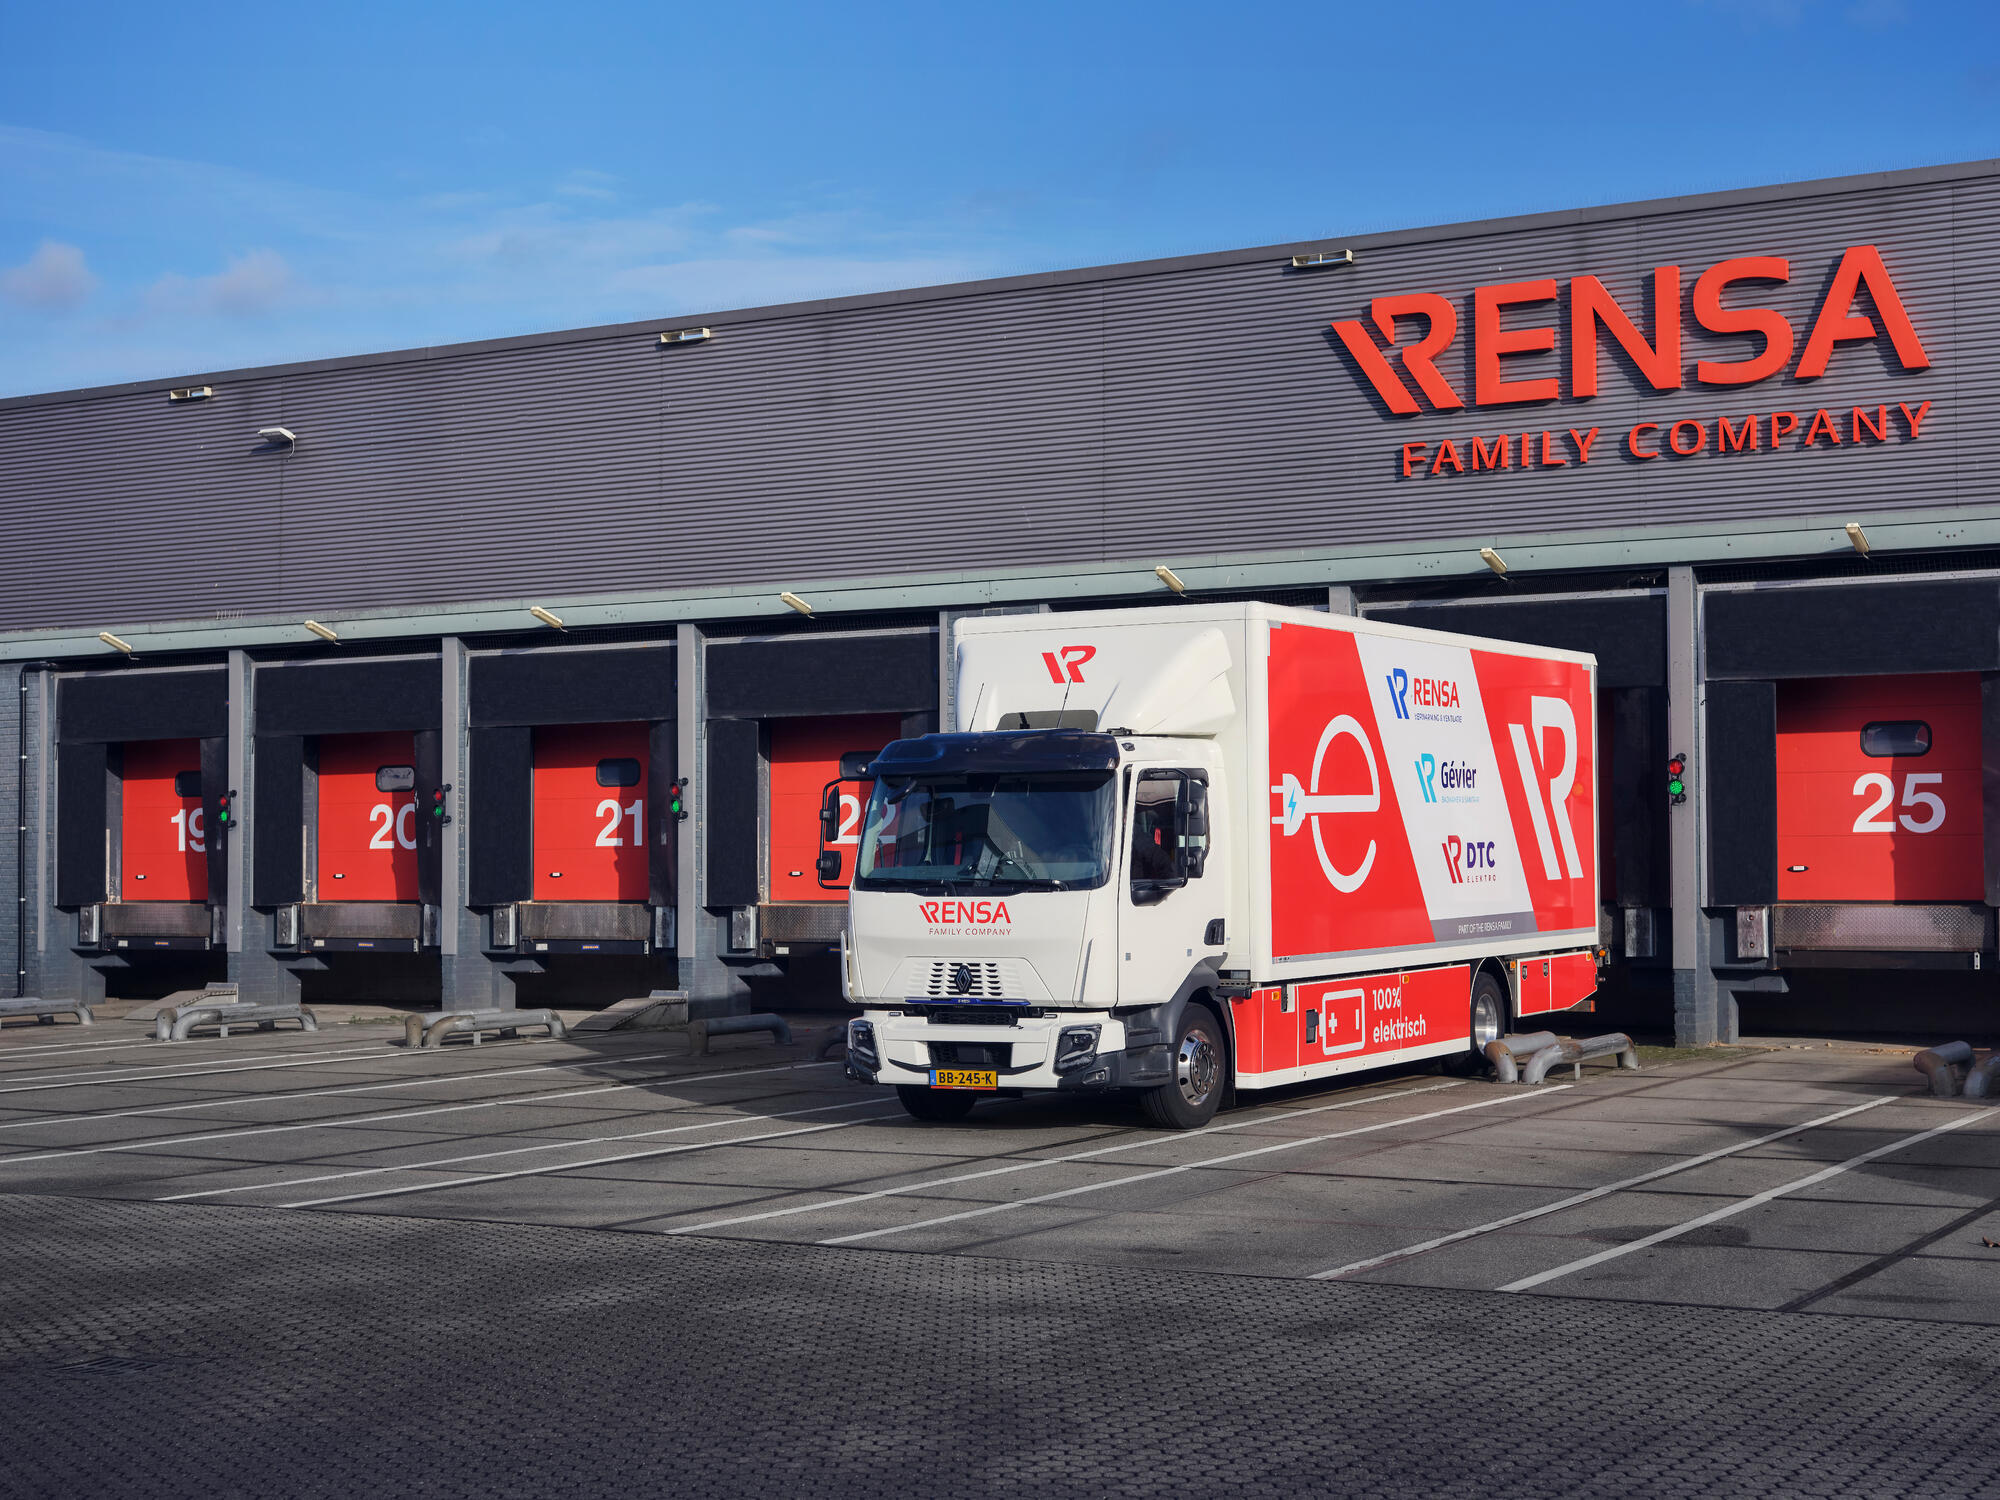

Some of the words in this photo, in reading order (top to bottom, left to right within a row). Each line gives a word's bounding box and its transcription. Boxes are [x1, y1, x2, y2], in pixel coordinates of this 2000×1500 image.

[1332, 245, 1931, 414] RENSA
[1403, 427, 1599, 477] FAMILY
[1628, 400, 1931, 459] COMPANY
[1413, 677, 1460, 709] RENSA
[1441, 760, 1477, 789] Gévier
[1852, 772, 1946, 834] 25
[171, 807, 206, 852] 19
[369, 803, 417, 850] 20
[595, 799, 643, 847] 21
[1467, 841, 1496, 868] DTC
[919, 901, 1011, 924] RENSA
[929, 928, 961, 936] FAMILY
[965, 928, 1011, 936] COMPANY
[1373, 986, 1401, 1011] 100%
[1373, 1014, 1426, 1043] elektrisch
[938, 1071, 993, 1085] BB-245-K
